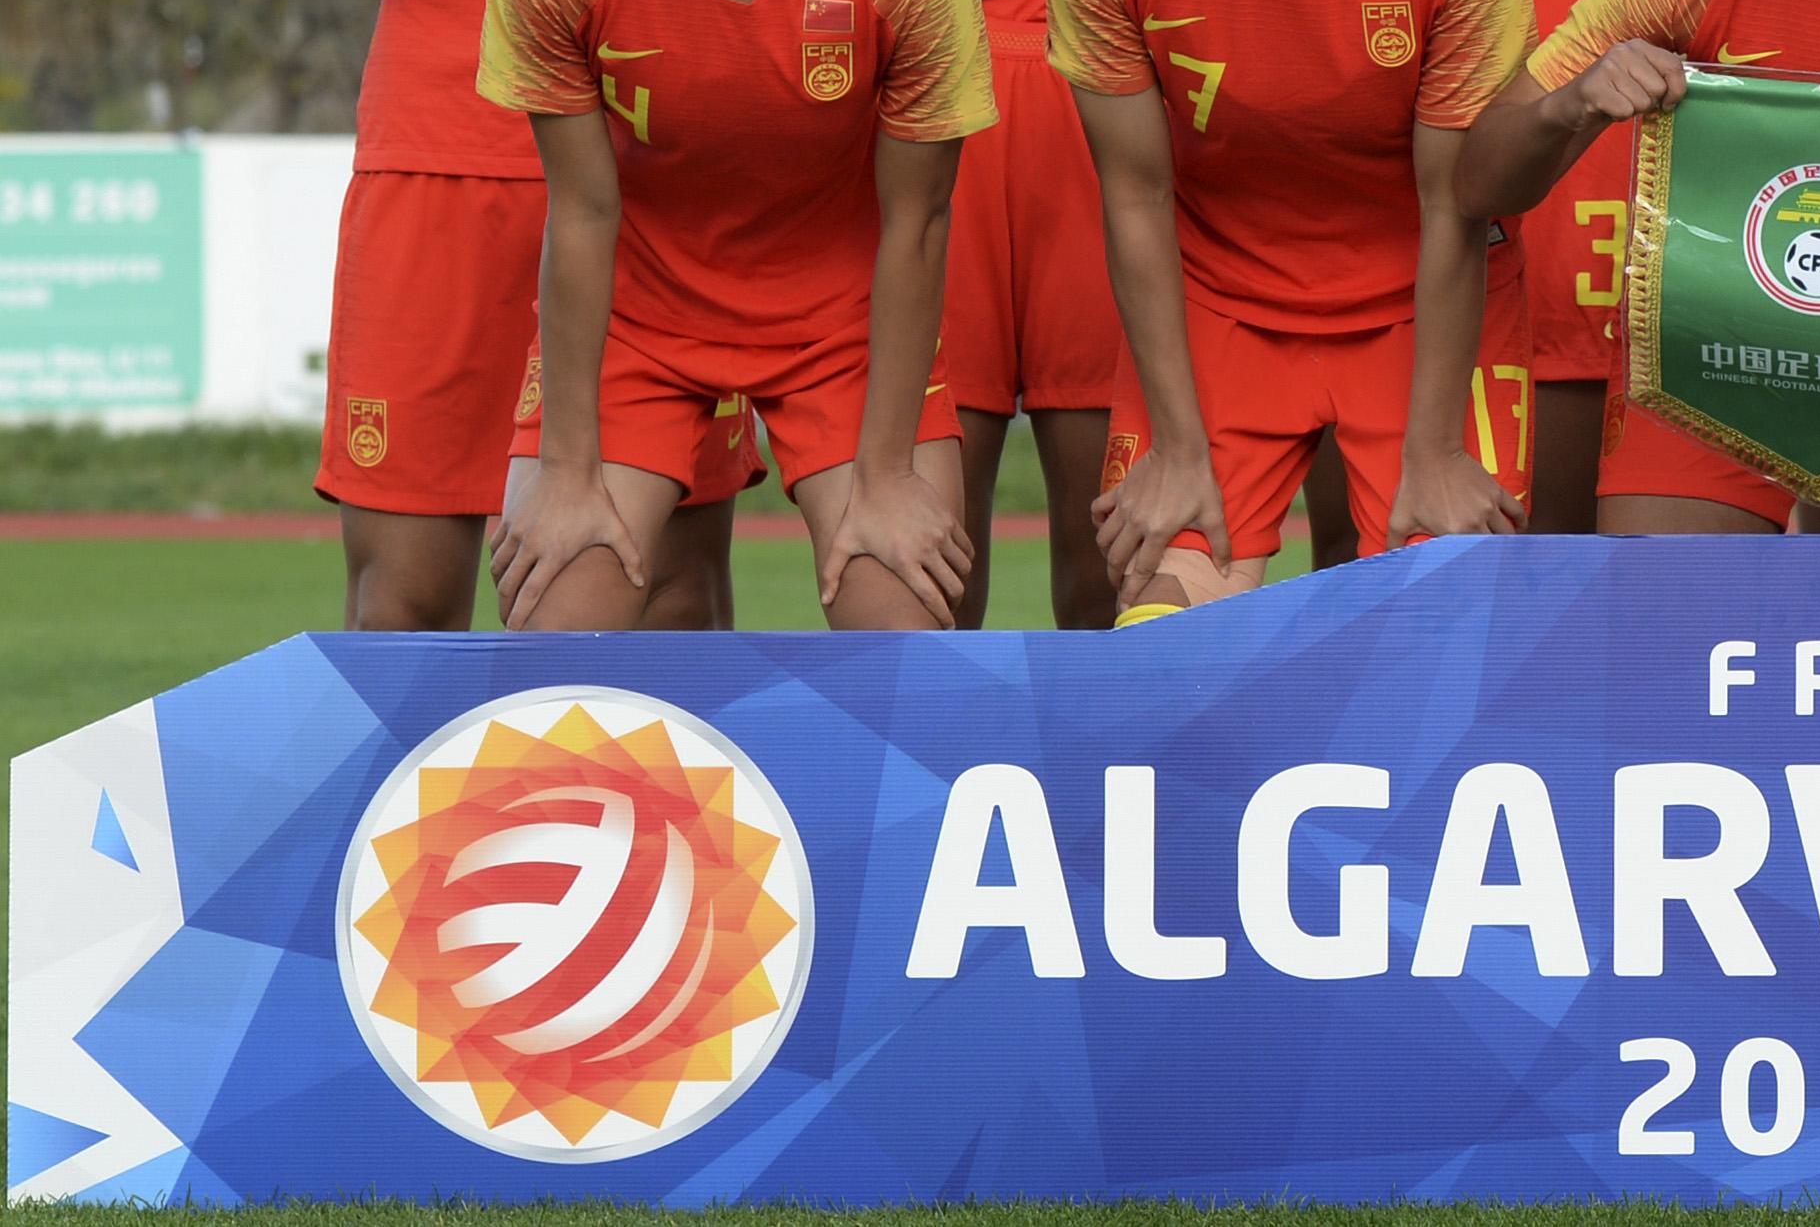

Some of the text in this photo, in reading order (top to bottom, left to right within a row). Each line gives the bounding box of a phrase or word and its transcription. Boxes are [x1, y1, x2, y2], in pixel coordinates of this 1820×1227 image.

[1366, 6, 1408, 19] CFA
[807, 46, 848, 57] CFA
[602, 74, 651, 145] 4
[1702, 371, 1758, 386] CHINESE
[351, 402, 383, 416] CFA
[1472, 365, 1528, 475] 17
